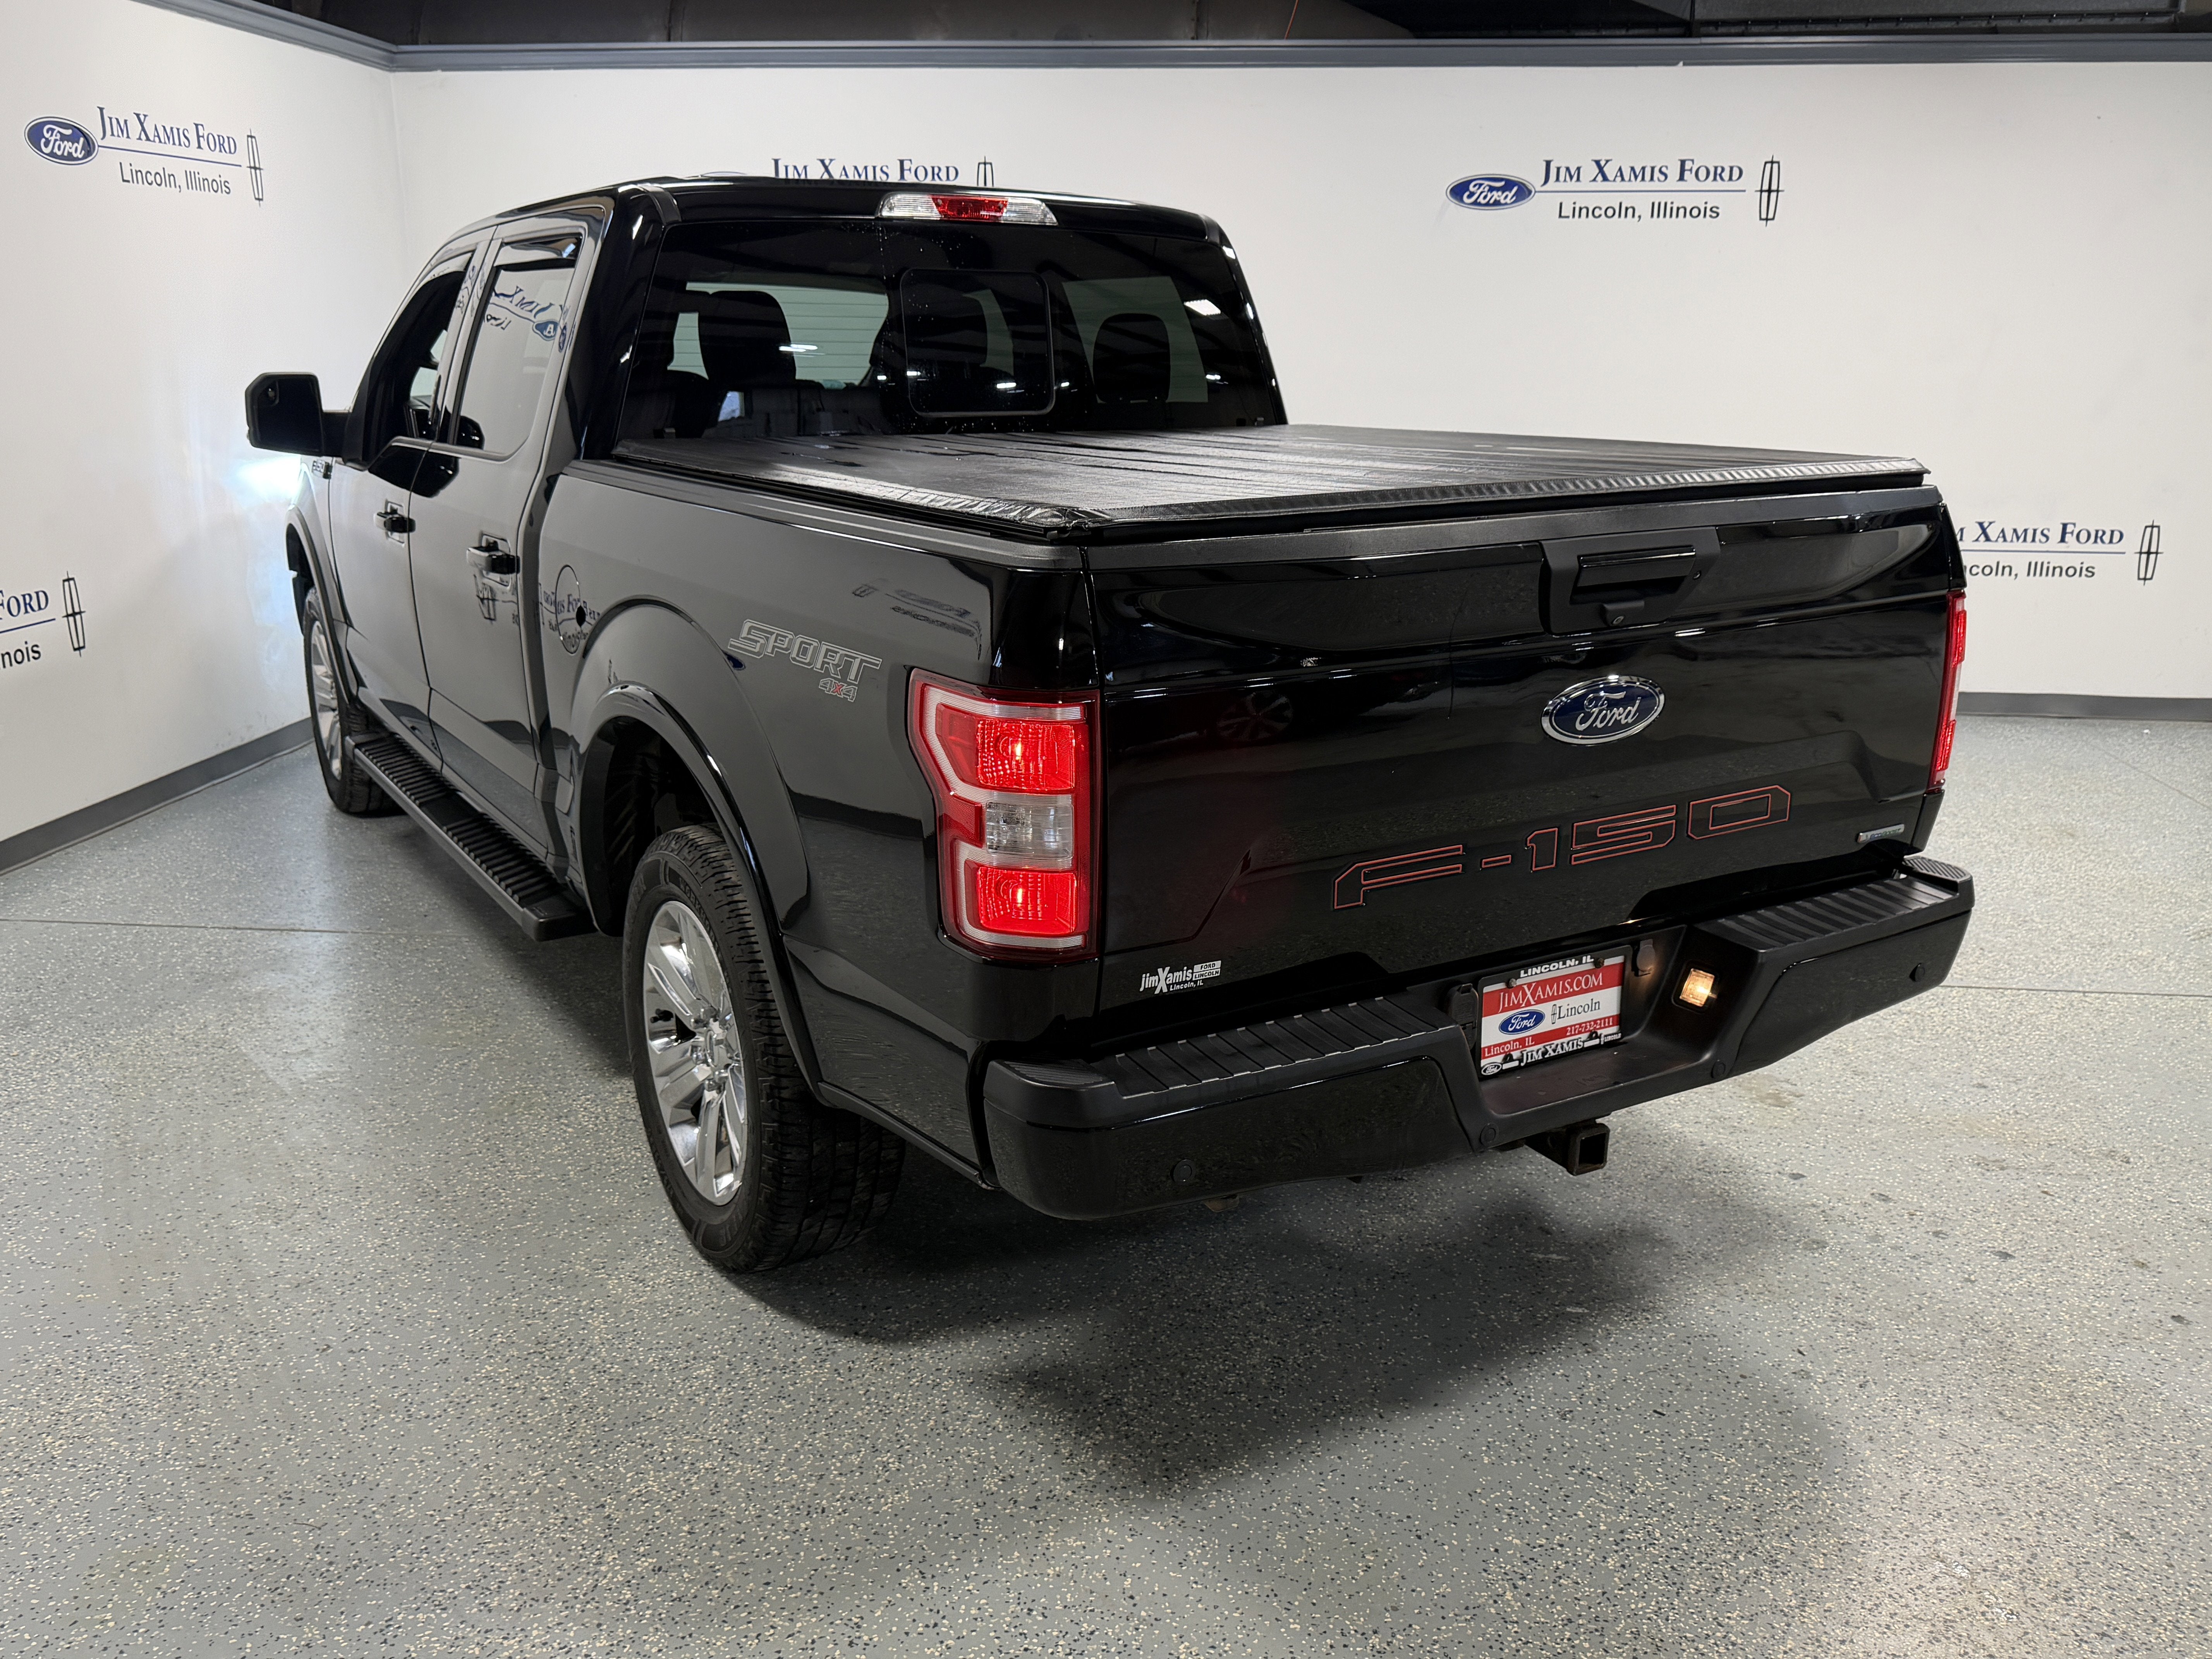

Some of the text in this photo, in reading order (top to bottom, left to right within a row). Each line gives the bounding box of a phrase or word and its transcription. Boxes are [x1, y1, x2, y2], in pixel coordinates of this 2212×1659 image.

[41, 124, 85, 159] Ford
[97, 106, 237, 155] JIM XAMIS FORD
[119, 162, 231, 195] Lincoln, Illinois
[816, 158, 890, 181] XAMIS
[897, 159, 959, 182] FORD
[1540, 159, 1744, 187] JIM XAMIS FORD
[1463, 180, 1516, 204] Ford
[1558, 201, 1721, 222] Lincoln, Illinois
[1972, 520, 2051, 544] XAMIS
[2057, 522, 2124, 545] FORD
[1964, 561, 2096, 580] coln, Illinois
[728, 619, 883, 685] SPORT
[1575, 690, 1642, 731] Ford
[1333, 785, 1791, 910] F-150
[1194, 970, 1219, 979] LINCOLN
[1200, 962, 1216, 970] FORD
[1520, 955, 1594, 978] LINCOLN, IL
[1140, 967, 1193, 994] jimXamis
[1170, 981, 1196, 991] Lincoln,
[1498, 972, 1603, 1013] JIMXAMIS.COM
[1557, 998, 1601, 1020] Lincoln
[1508, 1013, 1537, 1031] Ford
[1566, 1017, 1613, 1036] 217-732-2111
[1484, 1036, 1535, 1057] Lincoln, IL
[1520, 1038, 1583, 1066] JIM XAMIS
